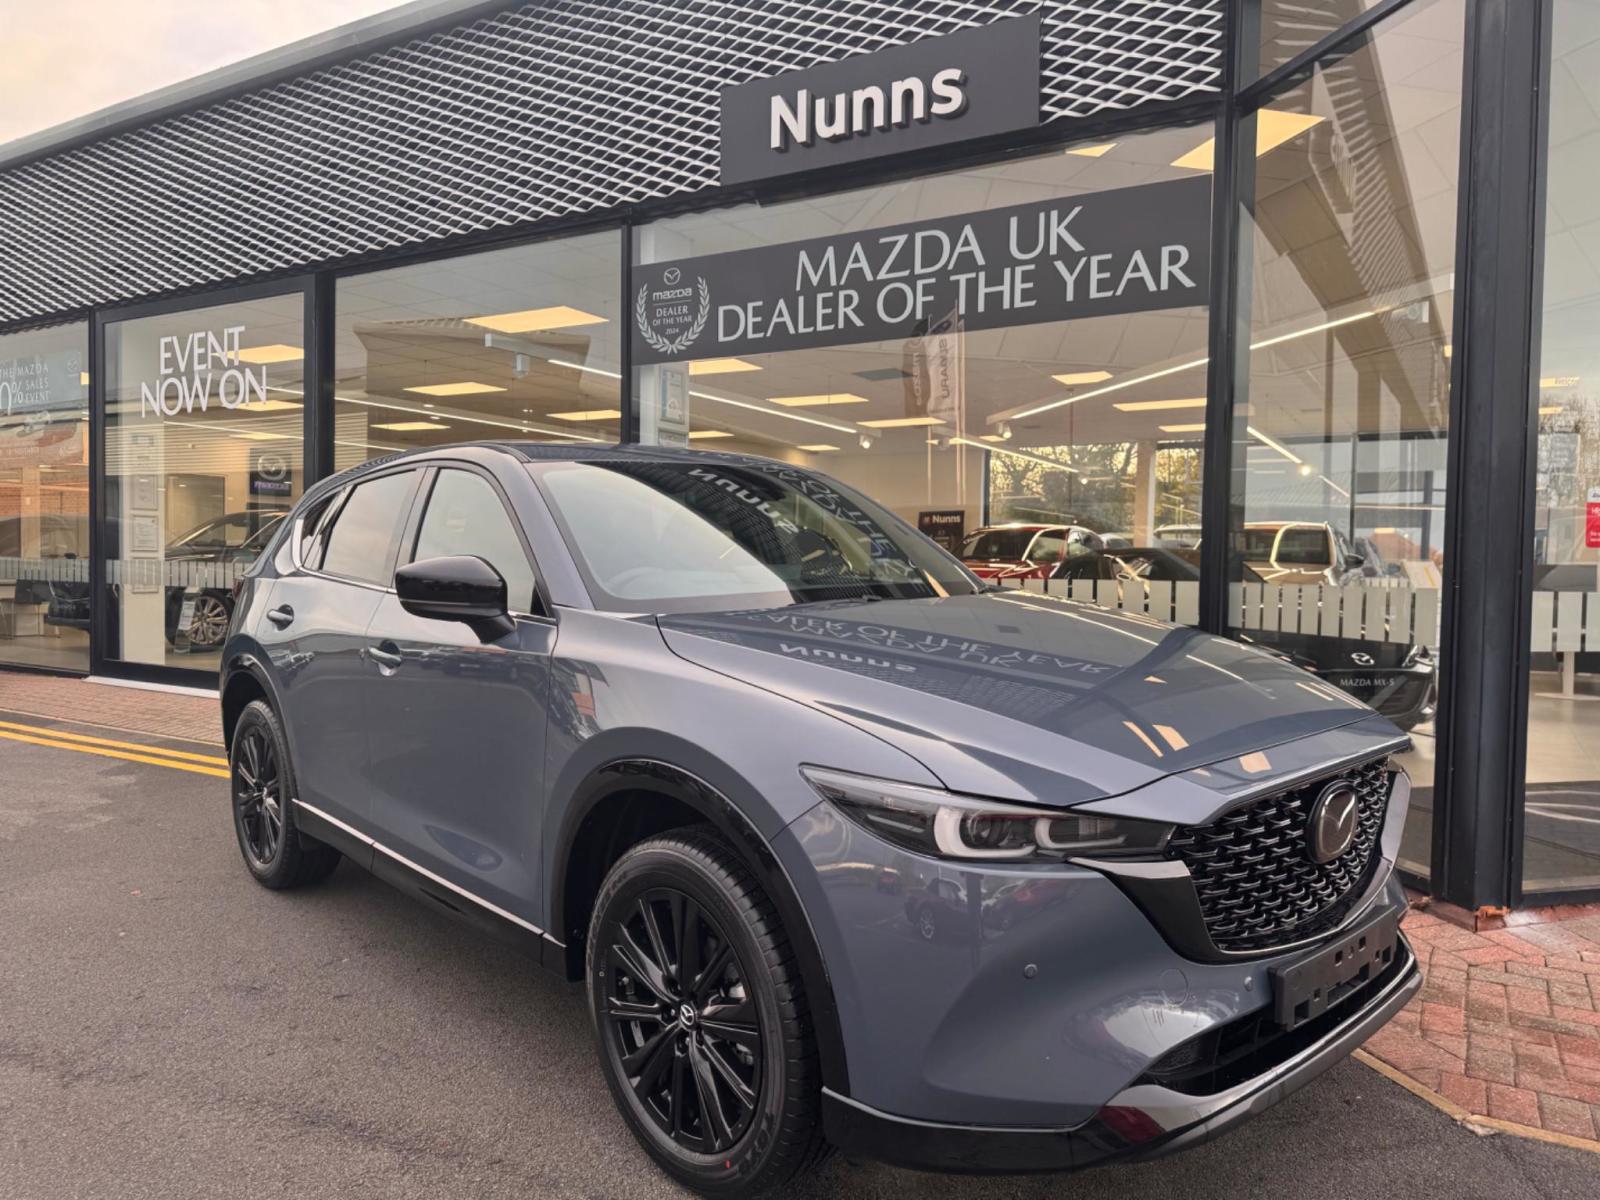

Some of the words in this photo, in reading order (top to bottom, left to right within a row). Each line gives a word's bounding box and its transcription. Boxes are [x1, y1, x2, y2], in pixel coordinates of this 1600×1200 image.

[770, 67, 967, 151] Nunns
[796, 223, 986, 291] MAZDA
[1008, 205, 1086, 261] UK
[656, 305, 689, 318] DEALER
[717, 289, 865, 343] DEALER
[875, 277, 937, 324] OF
[949, 263, 1038, 316] THE
[1053, 244, 1197, 303] YEAR
[662, 317, 675, 326] THE
[160, 325, 246, 375] EVENT
[141, 372, 212, 419] NOW
[219, 365, 268, 410] ON
[932, 514, 961, 524] Nunns
[1340, 677, 1372, 687] MAZDA
